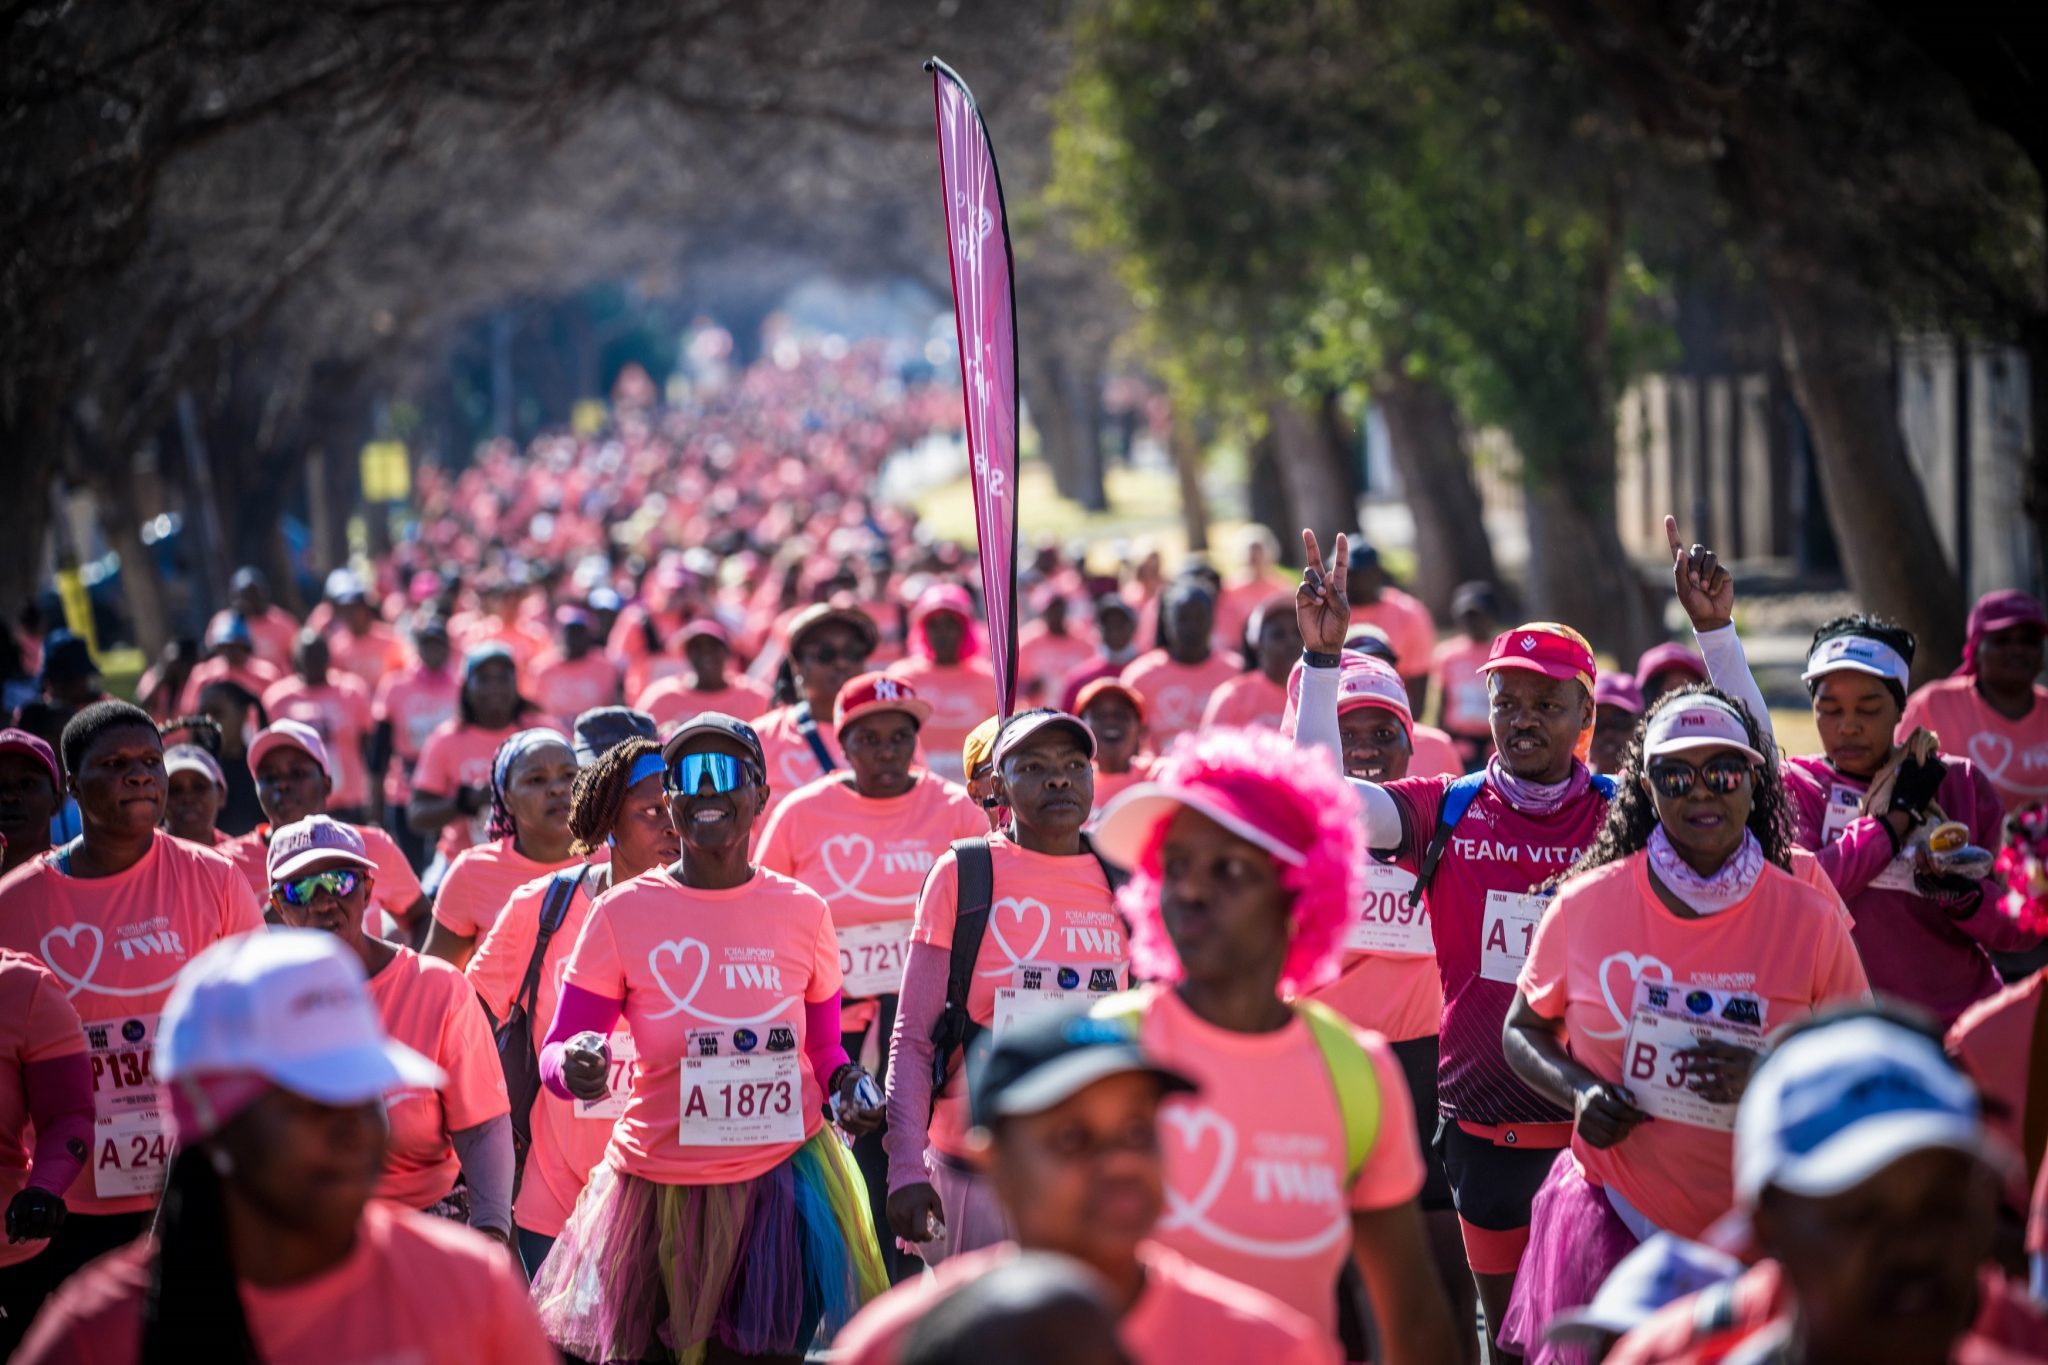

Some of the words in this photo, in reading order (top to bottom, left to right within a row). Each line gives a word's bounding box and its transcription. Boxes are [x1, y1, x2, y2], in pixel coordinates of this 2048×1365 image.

[1452, 836, 1518, 863] TEAM
[114, 929, 186, 961] TWR
[1060, 926, 1121, 957] TWR
[1486, 918, 1508, 954] A
[860, 942, 909, 973] 721
[719, 963, 783, 992] TWR
[1092, 971, 1115, 985] ASA
[770, 1031, 793, 1045] ASA
[1630, 1041, 1658, 1080] B
[685, 1084, 709, 1118] A
[719, 1081, 792, 1118] 1873
[99, 1136, 122, 1170] A
